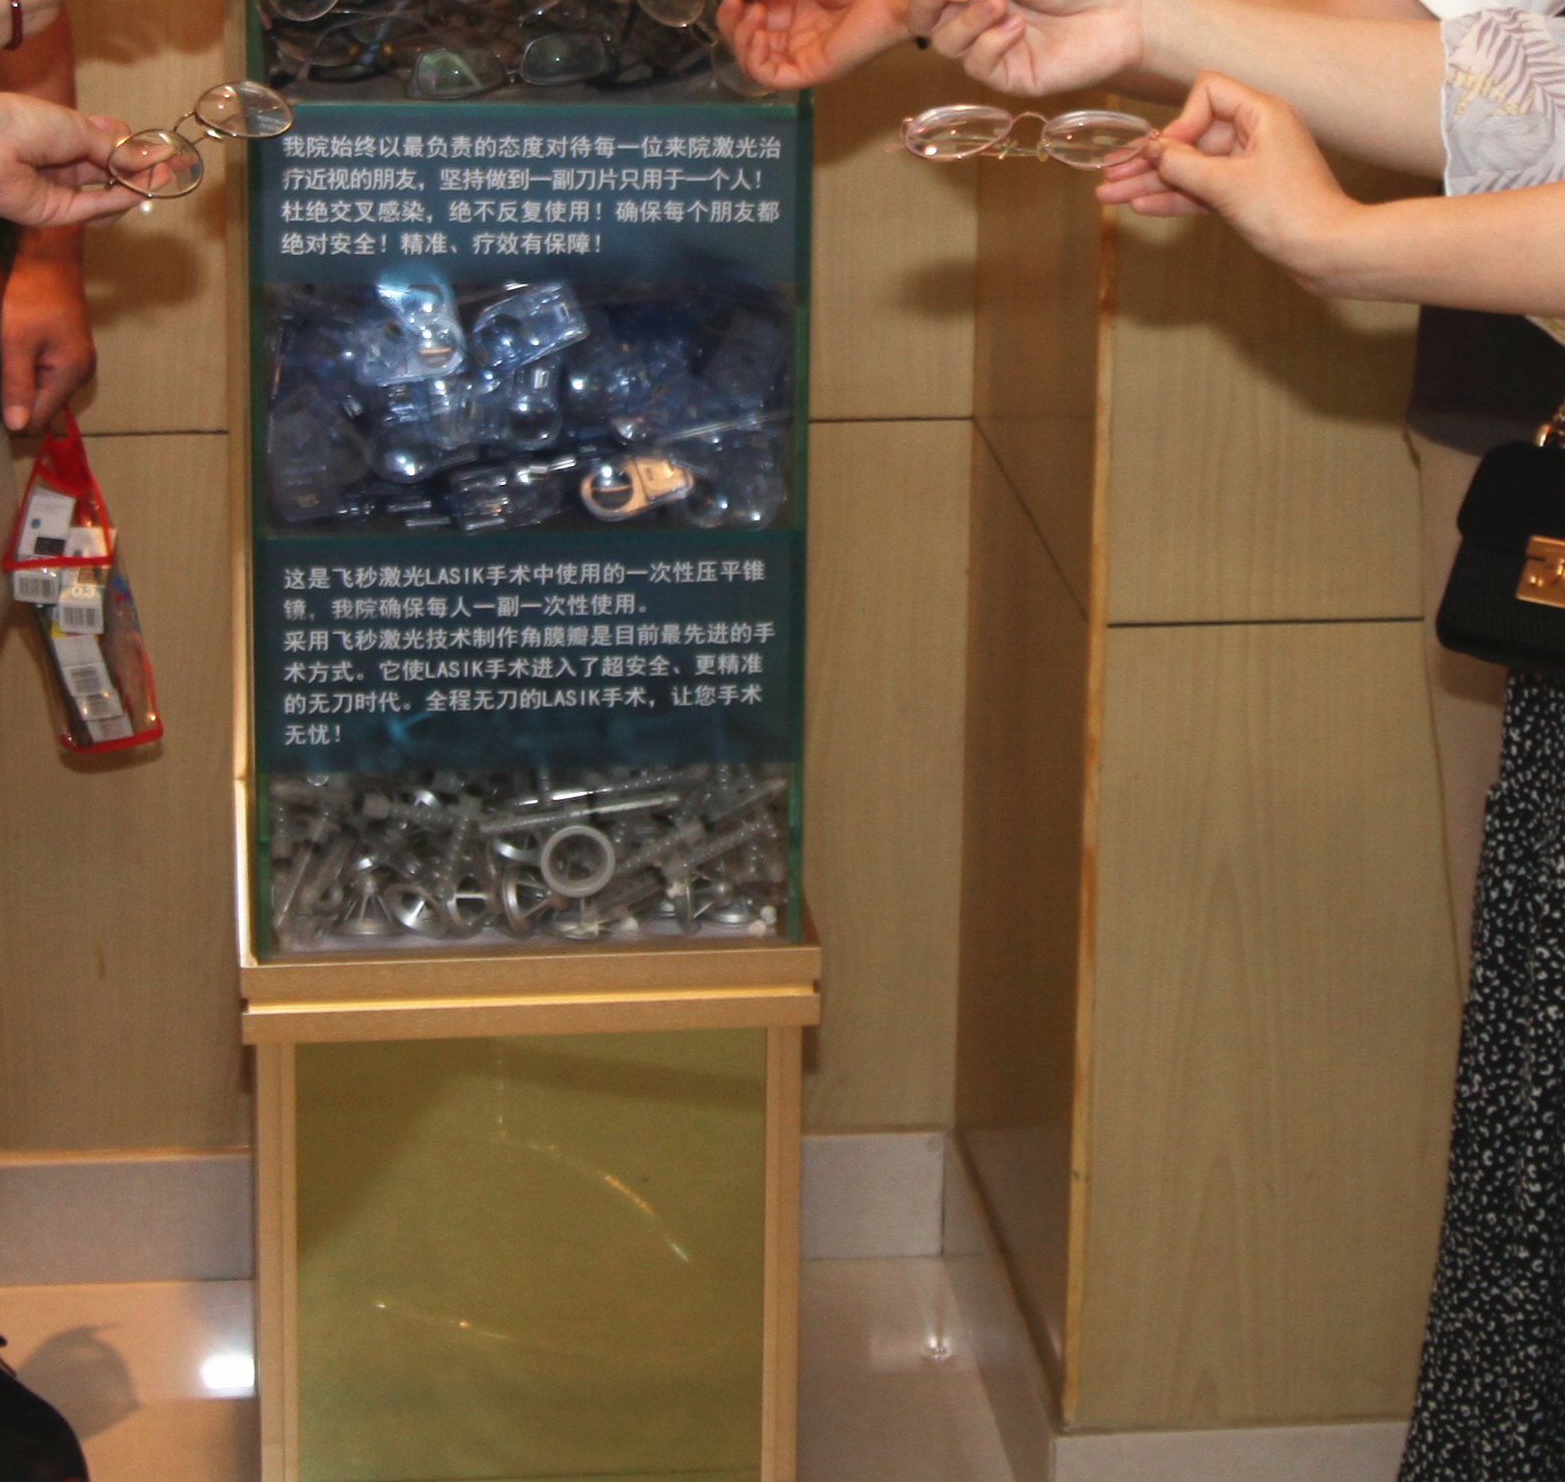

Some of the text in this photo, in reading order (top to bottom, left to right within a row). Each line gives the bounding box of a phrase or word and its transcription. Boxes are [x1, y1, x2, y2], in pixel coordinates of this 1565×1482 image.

[283, 135, 783, 160] 我院始终以最负责的态度对待每一位来院激光治
[283, 559, 766, 591] 这是飞秒激光LASIK手术中使用的一次性压平锥
[283, 622, 776, 653] 采用飞秒激光技术制作角膜瓣是目前最先进的手
